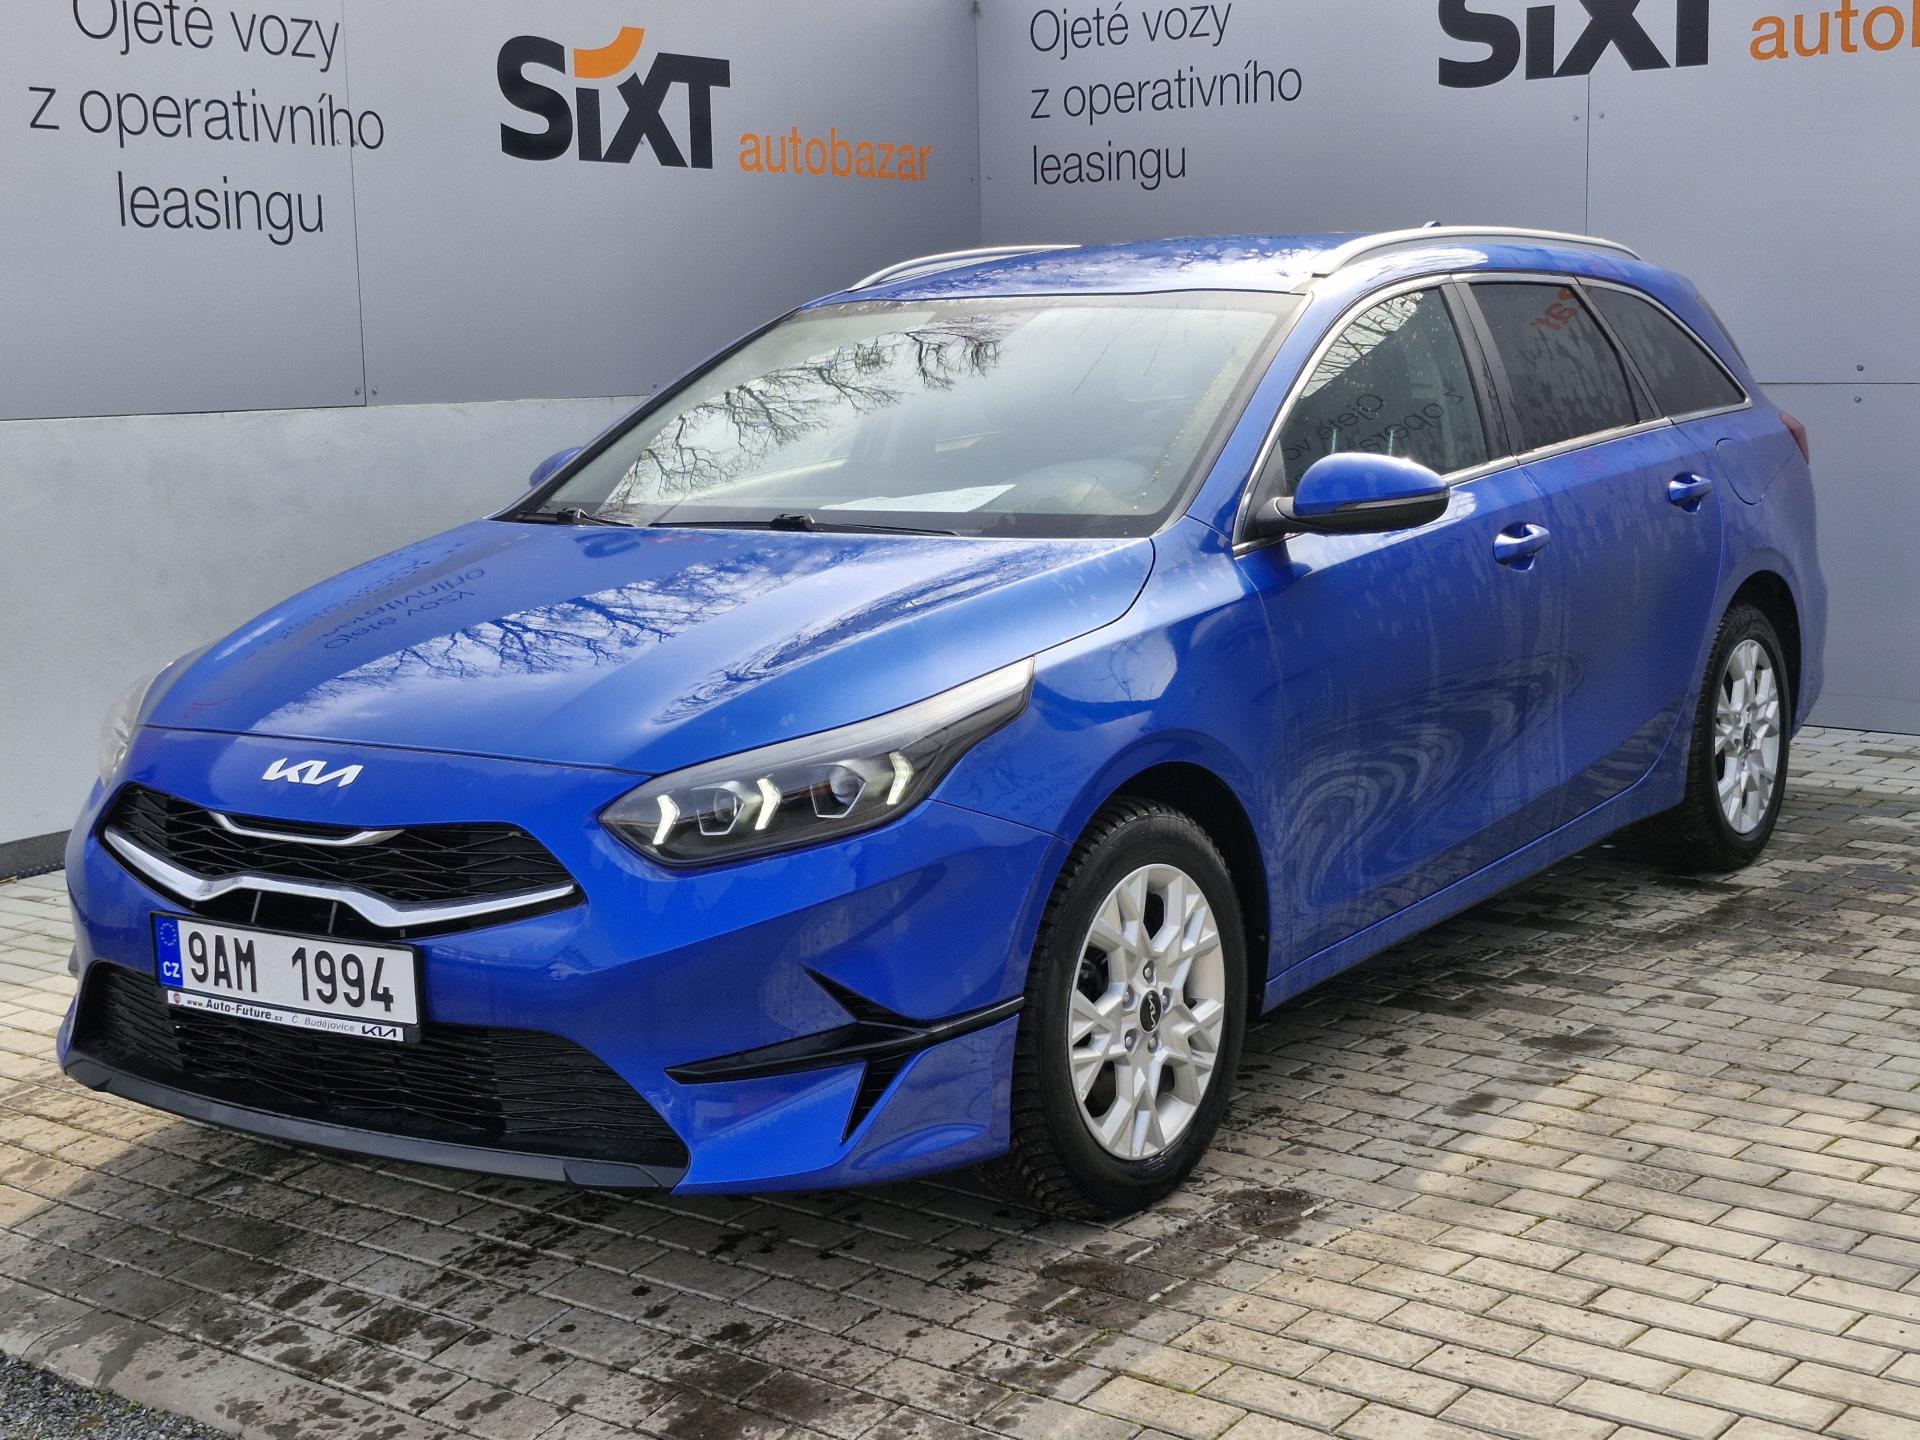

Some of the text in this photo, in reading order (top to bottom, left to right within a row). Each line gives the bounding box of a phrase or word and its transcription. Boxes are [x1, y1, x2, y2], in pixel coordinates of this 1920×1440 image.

[230, 12, 339, 73] vozy
[1030, 2, 1232, 60] Ojeté vozy
[29, 86, 385, 150] z operativního
[1030, 60, 1302, 125] z operativního
[739, 126, 933, 181] autobazar
[1033, 141, 1187, 191] leasingu
[117, 171, 324, 246] leasingu
[262, 757, 364, 788] KIA
[162, 960, 181, 979] CZ
[187, 930, 394, 1013] 9AM 1994
